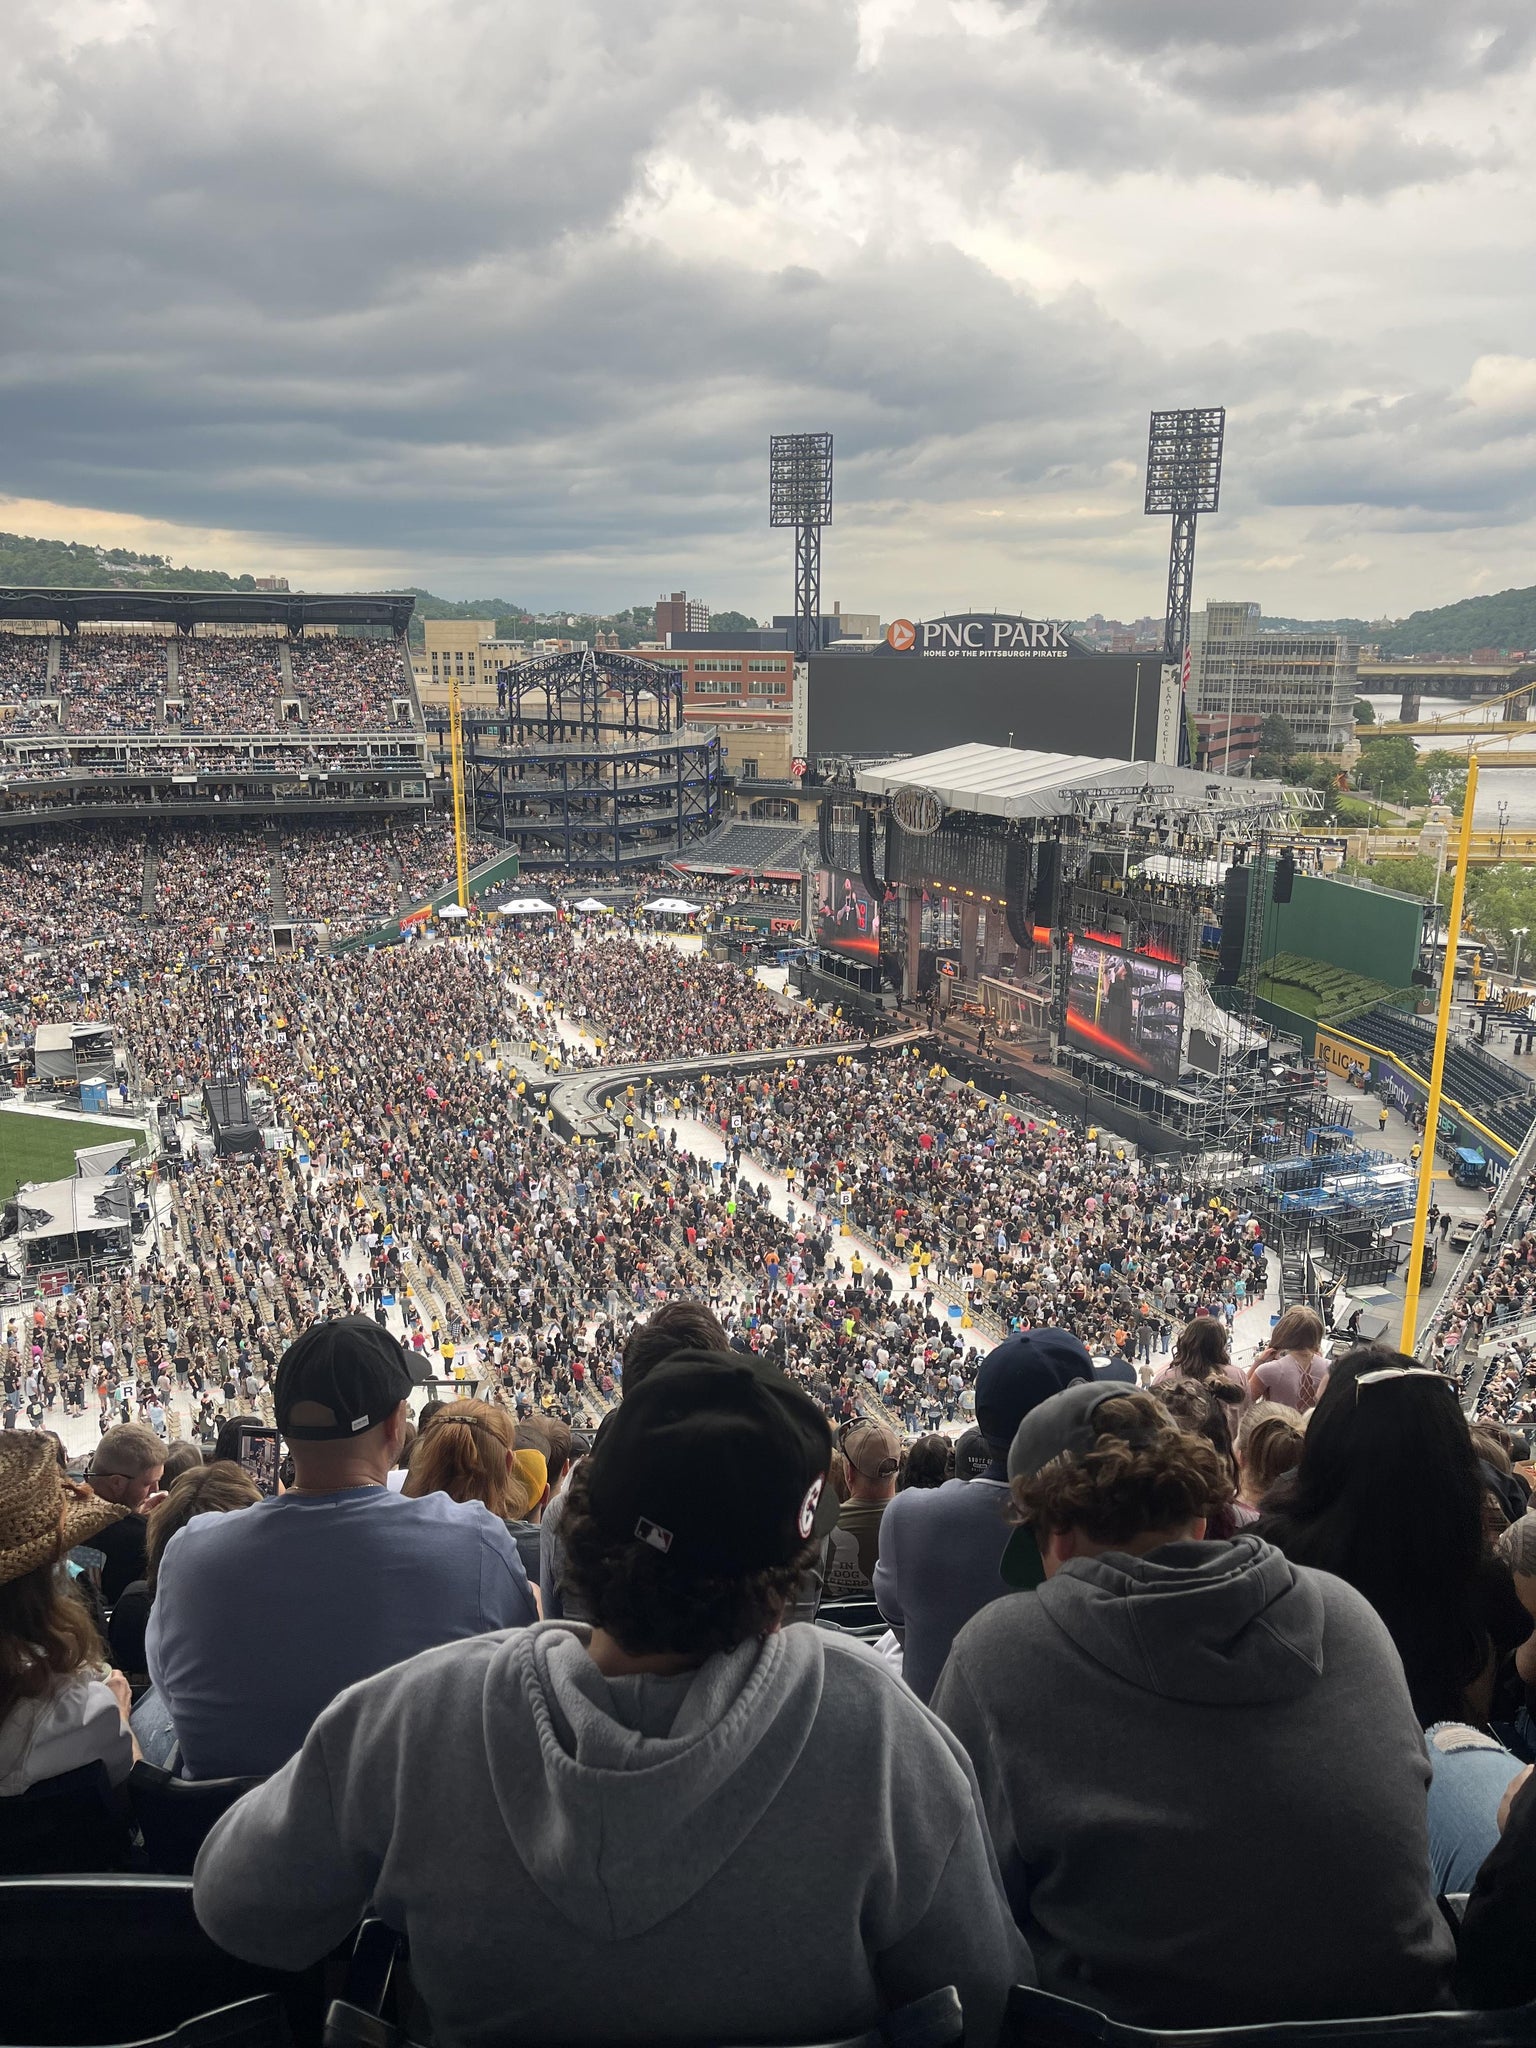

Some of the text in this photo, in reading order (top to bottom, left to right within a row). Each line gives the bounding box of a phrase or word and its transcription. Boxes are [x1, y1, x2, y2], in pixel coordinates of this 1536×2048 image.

[921, 622, 1070, 648] PNC PARK
[979, 650, 1031, 658] PITTSBURGH
[1164, 708, 1172, 727] MOR
[843, 1195, 849, 1203] B
[402, 1252, 410, 1260] K
[965, 1281, 972, 1290] A
[458, 1356, 464, 1366] J
[123, 1387, 133, 1397] R
[834, 1570, 860, 1579] DOG
